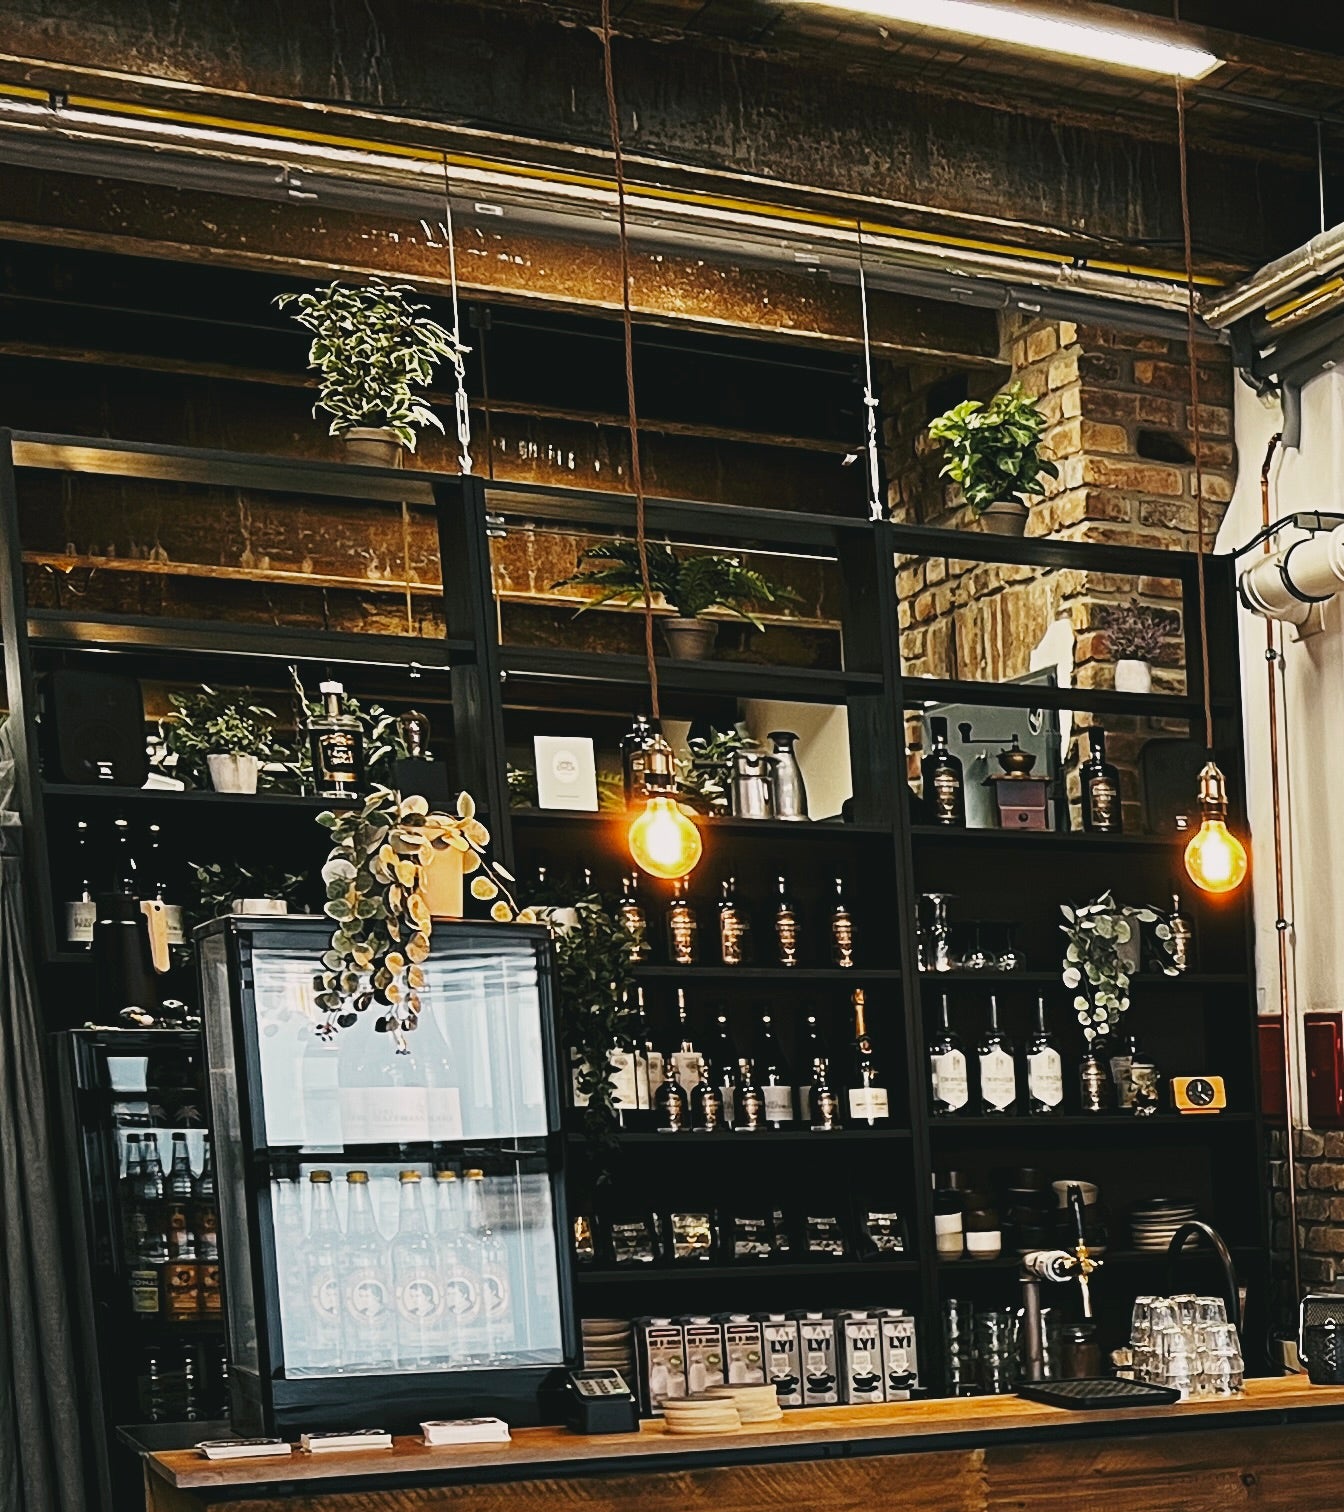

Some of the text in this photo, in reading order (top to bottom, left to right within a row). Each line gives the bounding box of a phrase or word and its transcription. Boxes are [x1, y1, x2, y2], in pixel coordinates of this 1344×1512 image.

[770, 1339, 794, 1353] LY!
[807, 1338, 831, 1351] LY!
[853, 1337, 875, 1350] LY!
[889, 1336, 912, 1348] LY!
